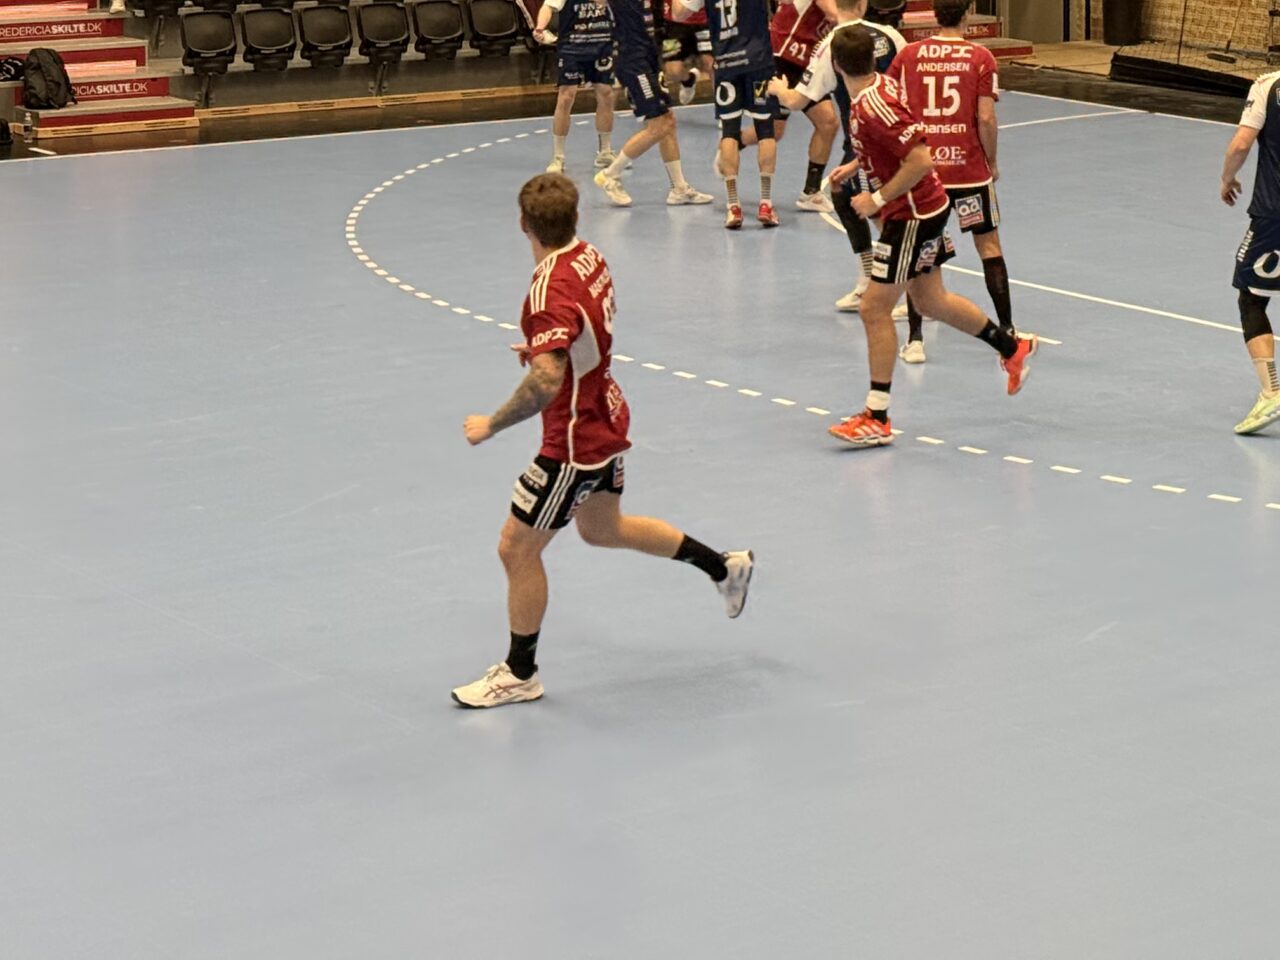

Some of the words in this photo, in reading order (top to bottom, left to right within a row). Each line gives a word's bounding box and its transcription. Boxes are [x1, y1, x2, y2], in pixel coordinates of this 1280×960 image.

[788, 41, 808, 60] 41
[916, 62, 970, 73] ANDERSEN
[922, 75, 961, 117] 15
